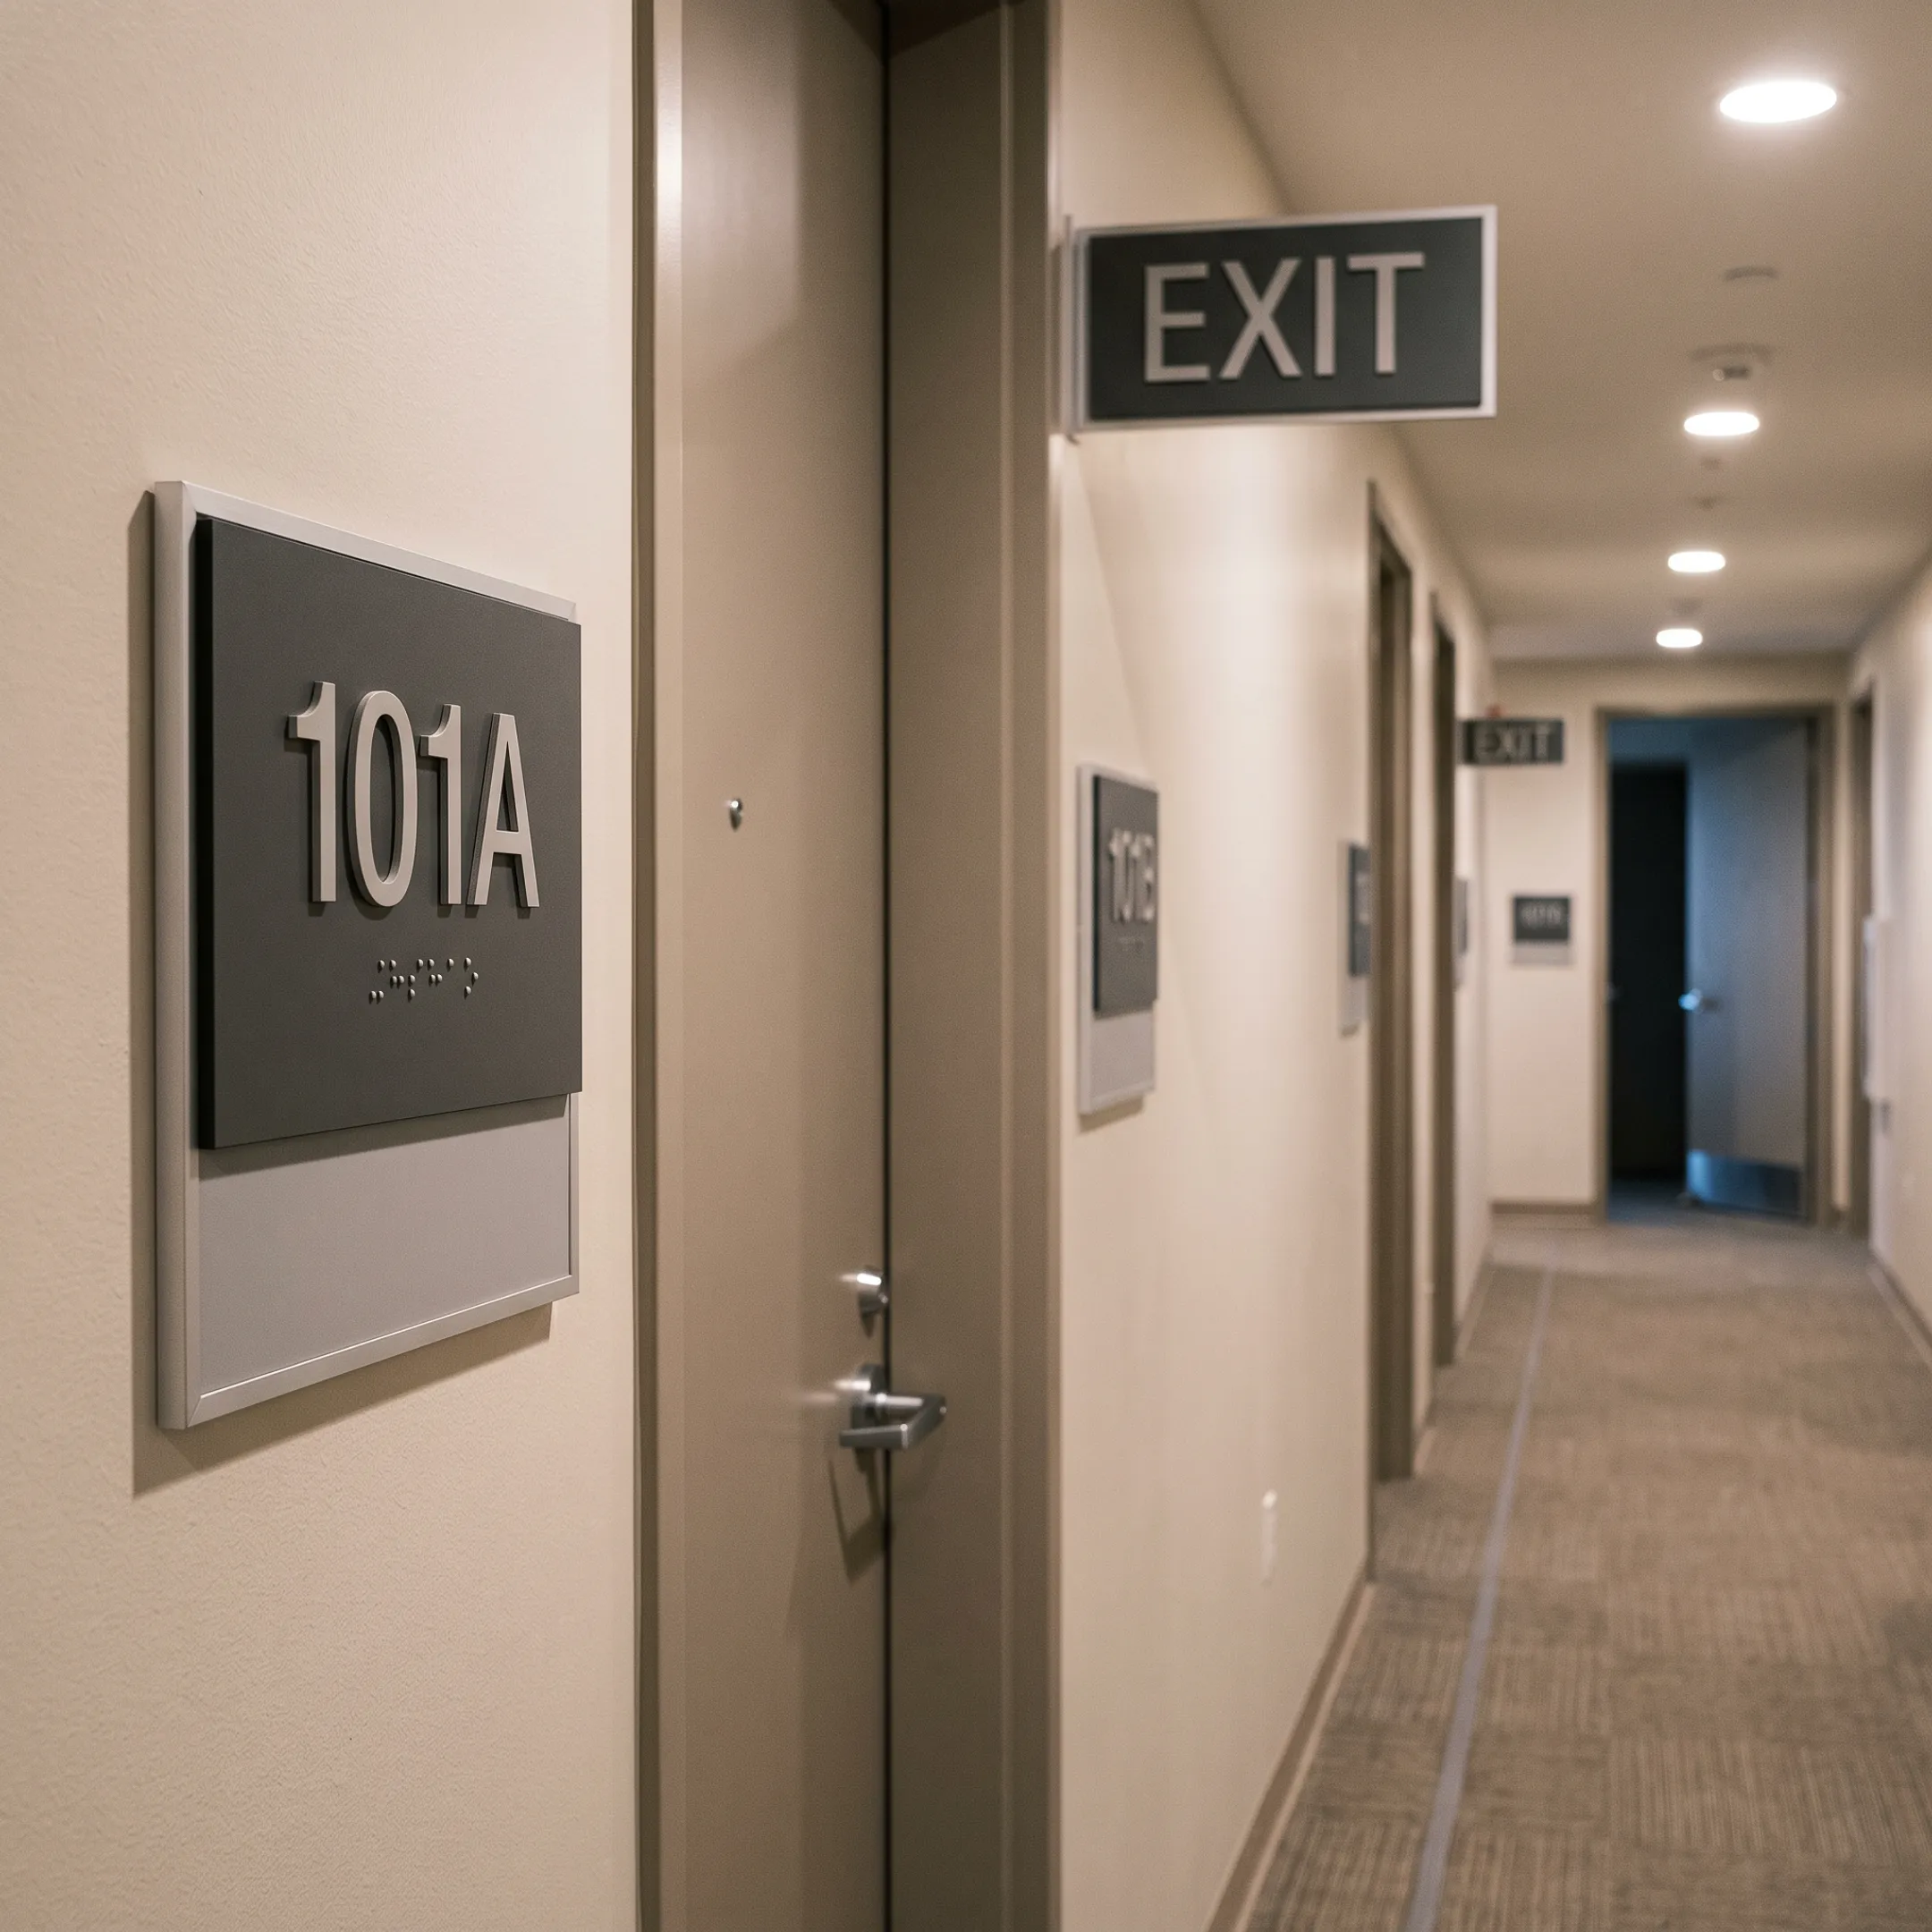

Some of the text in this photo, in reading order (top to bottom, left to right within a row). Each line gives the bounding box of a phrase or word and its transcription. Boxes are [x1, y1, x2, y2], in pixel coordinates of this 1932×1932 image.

[1144, 252, 1425, 383] EXIT
[286, 680, 540, 909] 101A
[1477, 724, 1552, 761] EXIT
